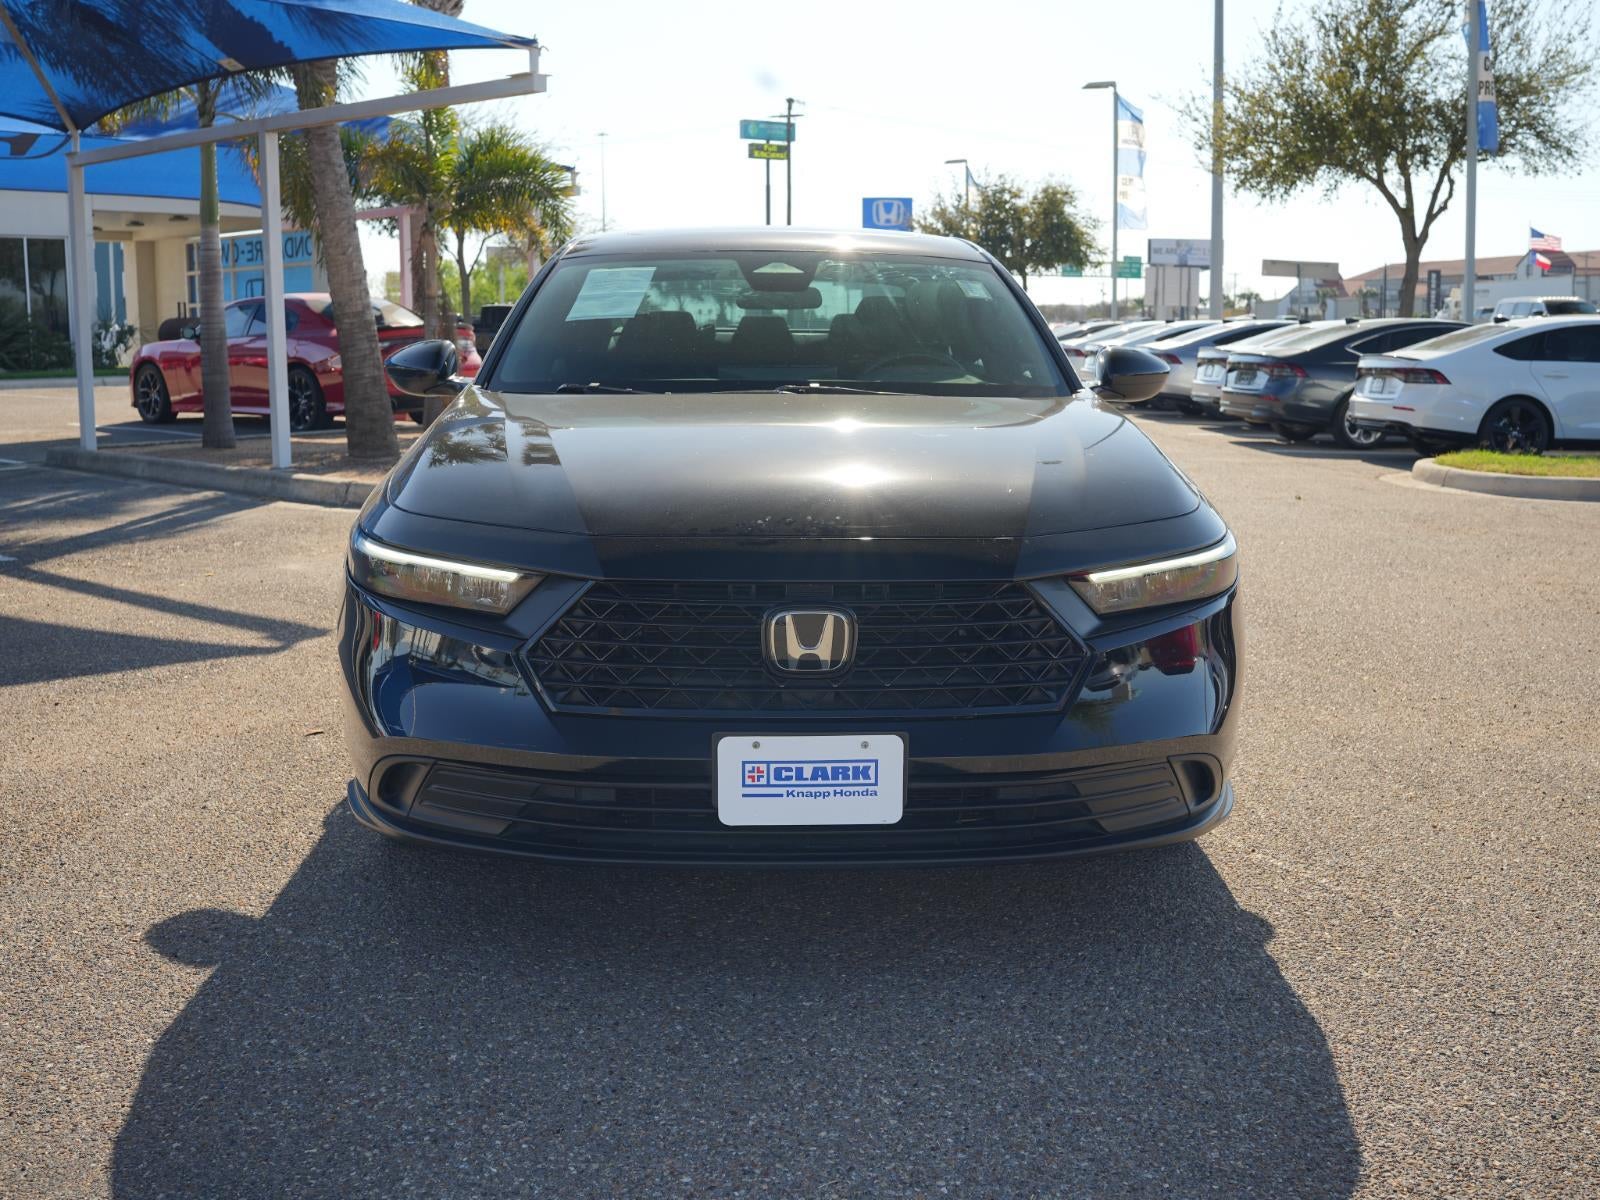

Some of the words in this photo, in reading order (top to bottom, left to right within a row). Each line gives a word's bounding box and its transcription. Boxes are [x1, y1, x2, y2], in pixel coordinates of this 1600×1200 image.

[773, 766, 872, 782] CLARK
[786, 789, 831, 799] Knapp
[833, 788, 878, 797] Honda
